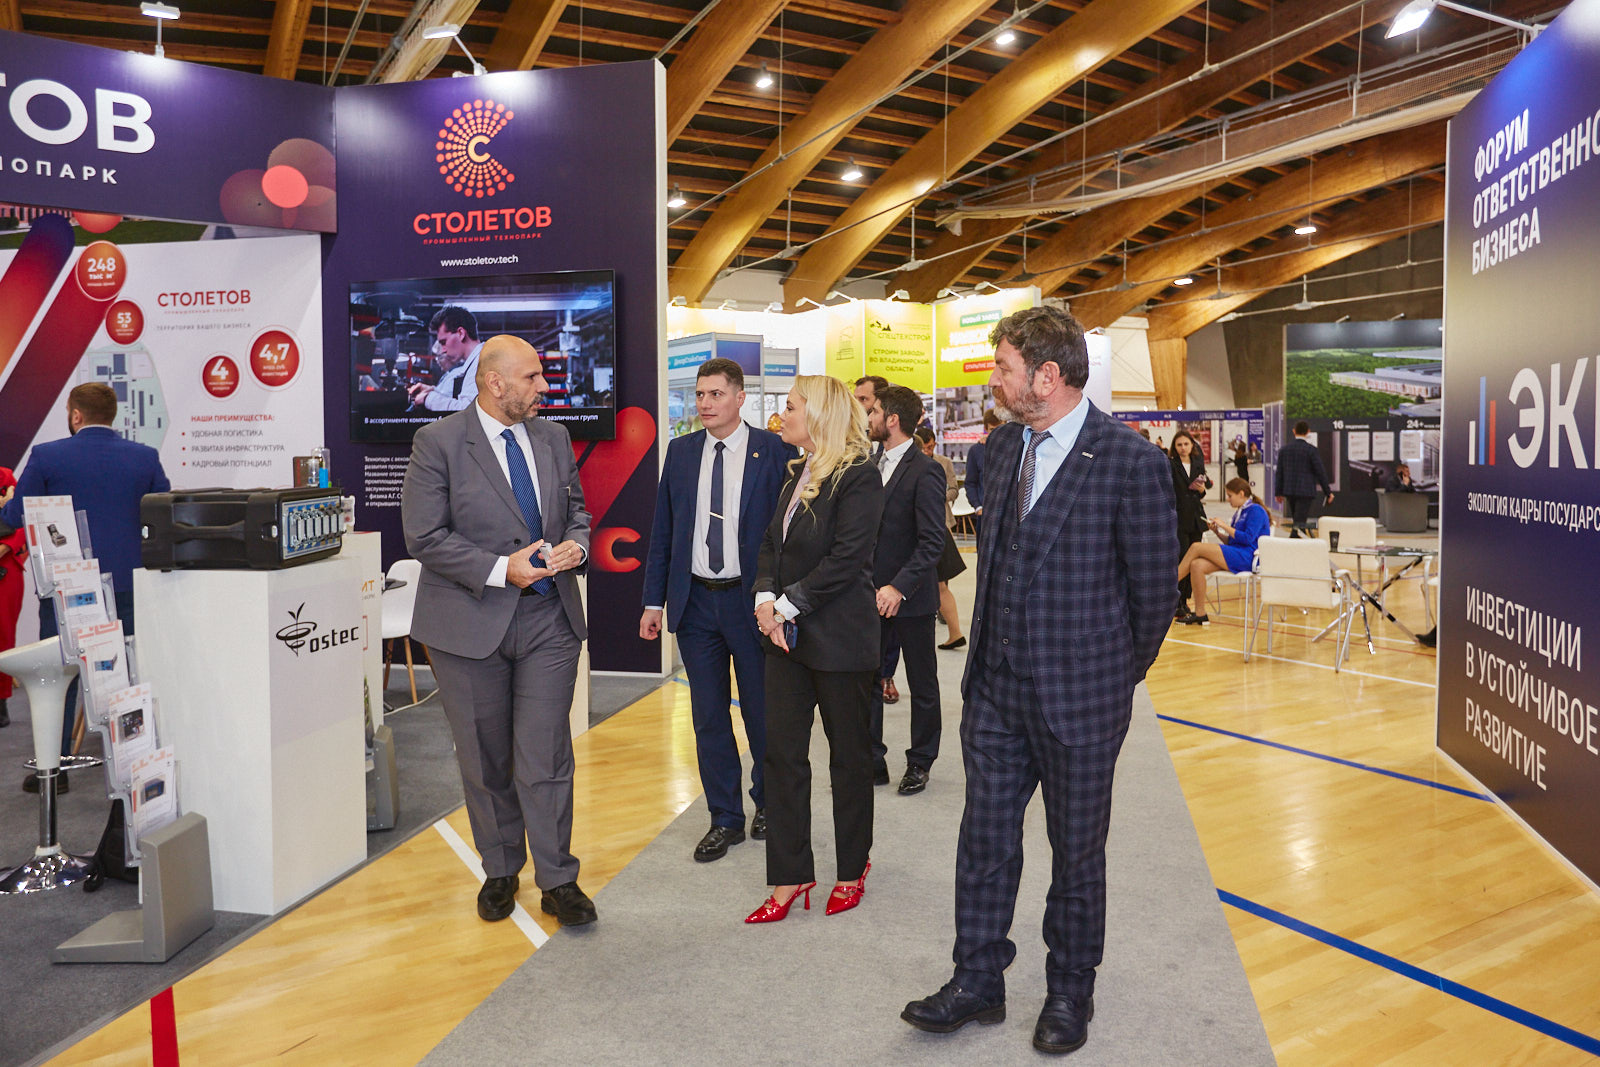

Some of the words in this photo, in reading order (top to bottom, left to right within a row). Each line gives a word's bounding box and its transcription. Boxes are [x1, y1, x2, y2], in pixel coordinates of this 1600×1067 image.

[1474, 107, 1529, 183] ФОРУМ
[0, 155, 117, 185] ОПАРК
[413, 206, 552, 235] СТОЛЕТОВ
[423, 235, 491, 245] ПРОМЫШЛЕННЫЙ
[494, 232, 542, 241] ТЕХНОПАРК
[1472, 206, 1541, 276] БИЗНЕСА
[87, 257, 116, 272] 248
[440, 254, 519, 267] www.stoletov.tech
[157, 289, 251, 307] СТОЛЕТОВ
[117, 312, 132, 324] 53
[156, 324, 195, 332] ТЕРРИТОРИЯ
[258, 343, 290, 364] 4,7
[210, 358, 229, 380] 4
[214, 414, 275, 422] ПРЕИМУЩЕСТВА:
[580, 414, 599, 422] групп
[1507, 354, 1600, 470] ЭК
[191, 430, 222, 438] УДОБНАЯ
[225, 444, 285, 452] ИНФРАСТРУКТУРА
[192, 460, 229, 469] КАДРОВЫЙ
[230, 460, 272, 468] ПОТЕНЦИАЛ
[1467, 492, 1508, 517] ЭКОЛОГИЯ
[1509, 497, 1542, 524] КАДРЫ
[309, 626, 359, 653] ostec
[1466, 585, 1581, 673] ИНВЕСТИЦИИ
[1466, 641, 1475, 679] В
[1478, 647, 1600, 756] УСТОЙЧИВОЕ
[1465, 697, 1547, 791] РАЗВИТИЕ
